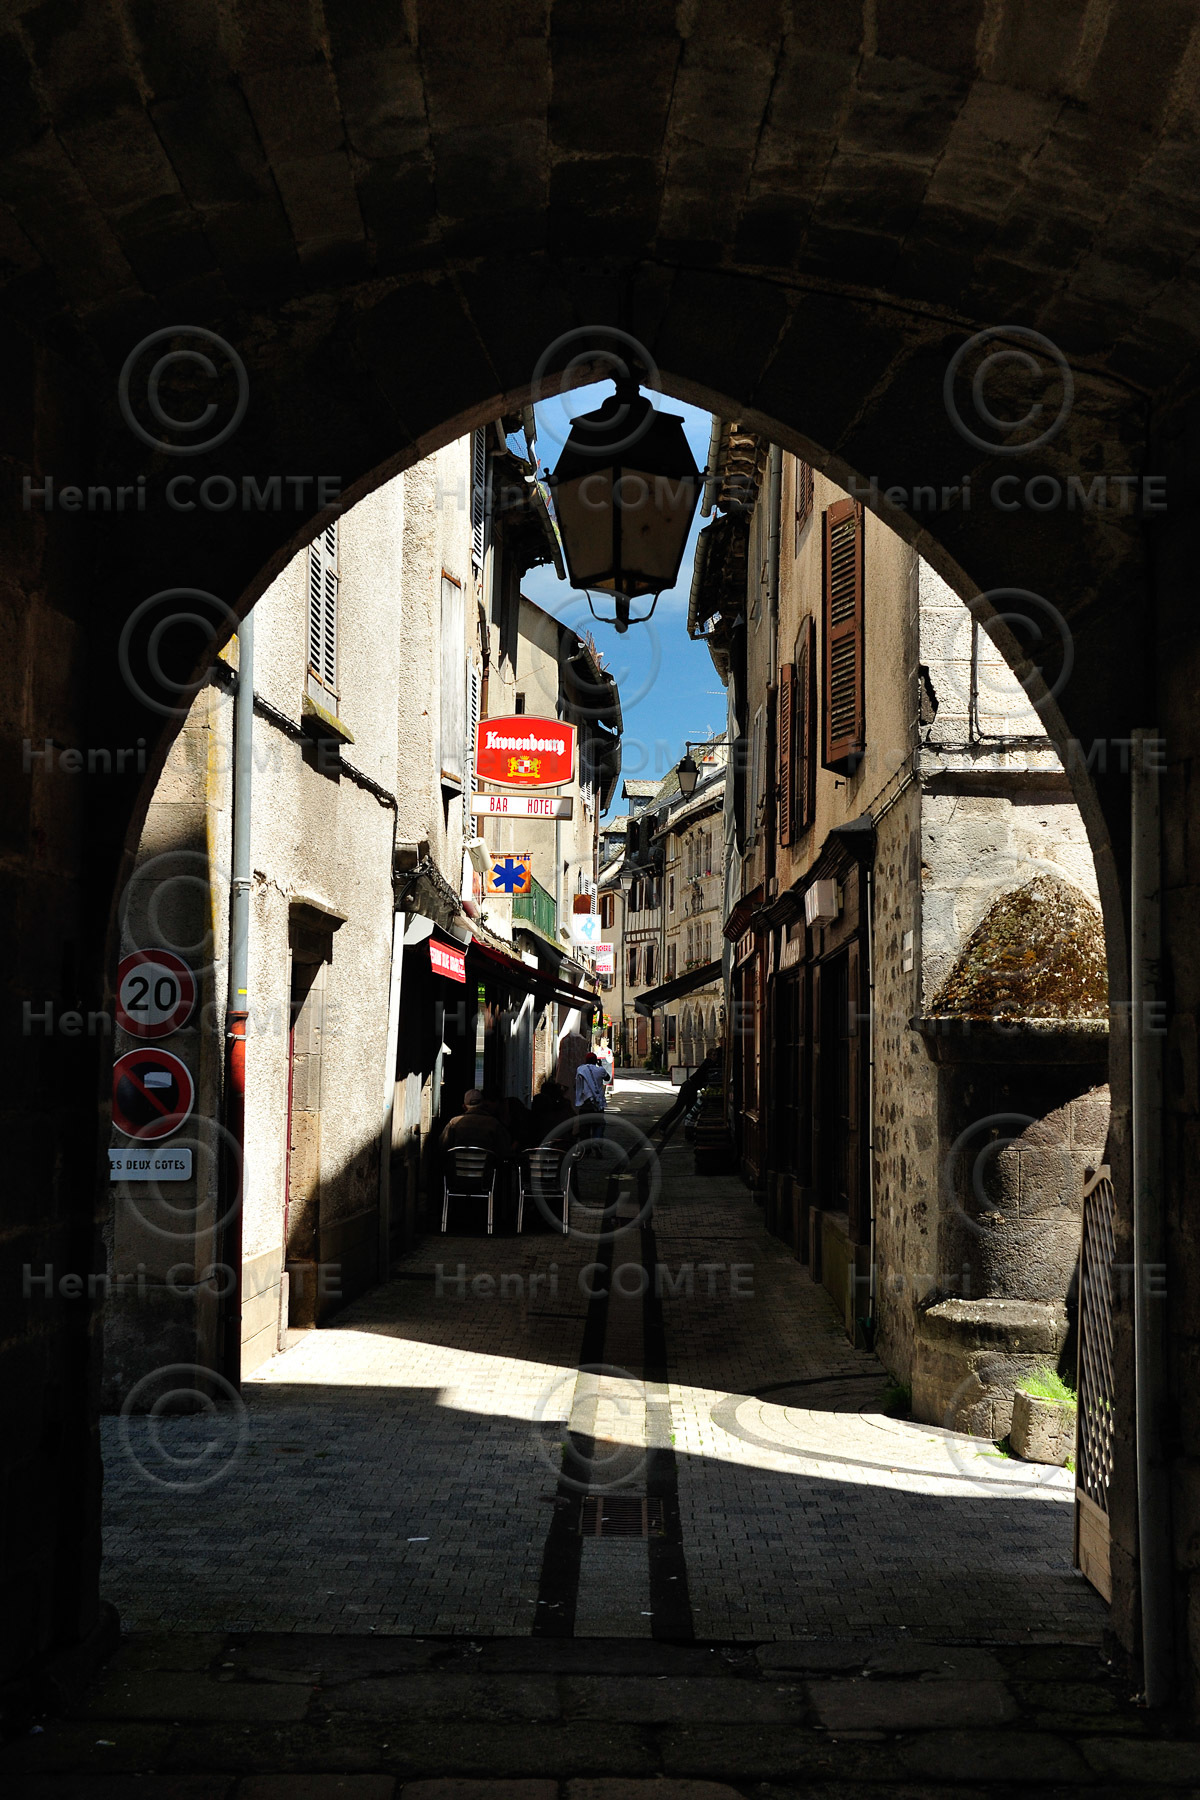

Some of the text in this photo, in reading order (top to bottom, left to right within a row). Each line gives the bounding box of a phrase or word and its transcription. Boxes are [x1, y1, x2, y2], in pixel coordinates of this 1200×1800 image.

[485, 731, 565, 757] Kronenbourg
[490, 797, 554, 815] BAR HOTEL
[127, 976, 177, 1011] 20
[126, 1160, 151, 1170] DEUX
